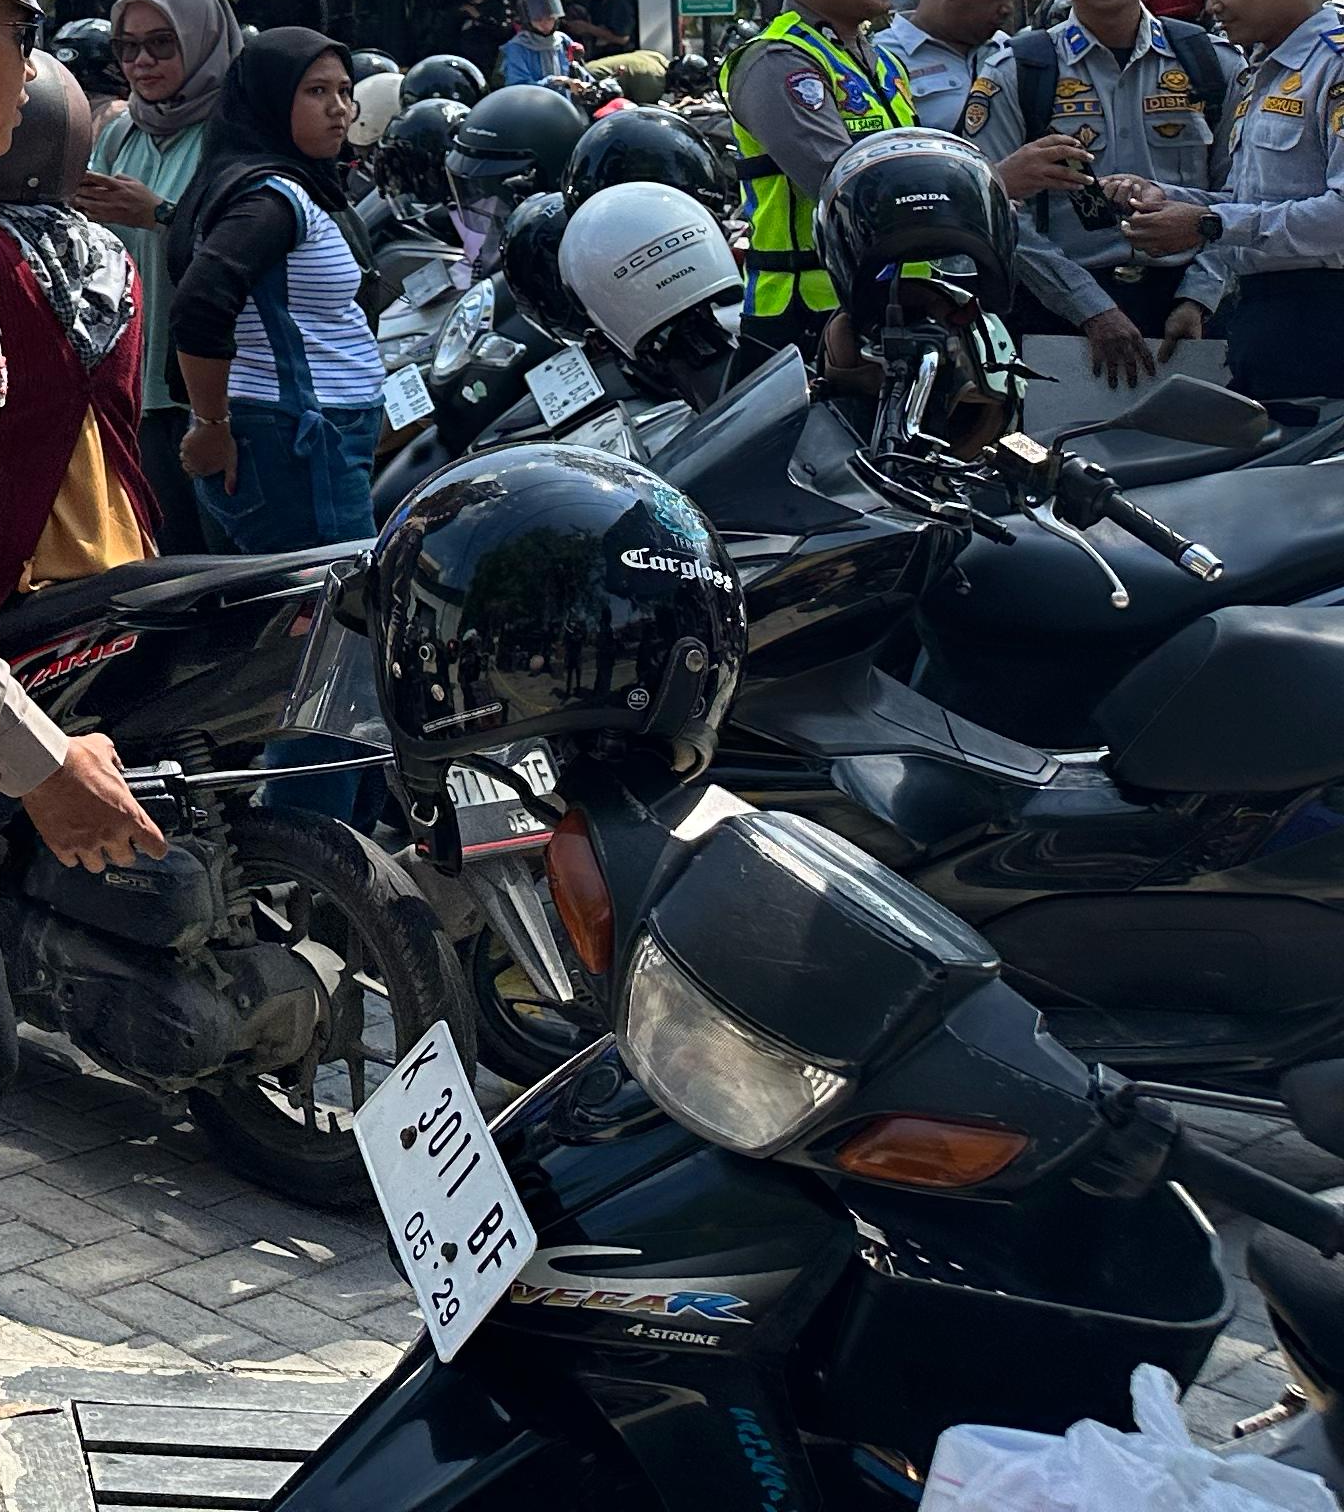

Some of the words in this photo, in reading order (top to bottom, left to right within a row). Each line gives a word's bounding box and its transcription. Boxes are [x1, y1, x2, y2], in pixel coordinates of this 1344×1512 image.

[895, 193, 951, 205] HONDA
[613, 227, 707, 279] SCOOPY
[655, 265, 696, 290] HONDA
[621, 547, 734, 592] Cargloss
[400, 1040, 438, 1090] K
[417, 1087, 481, 1198] 3011
[465, 1202, 515, 1275] BF
[625, 1322, 721, 1347] 4-STROKE
